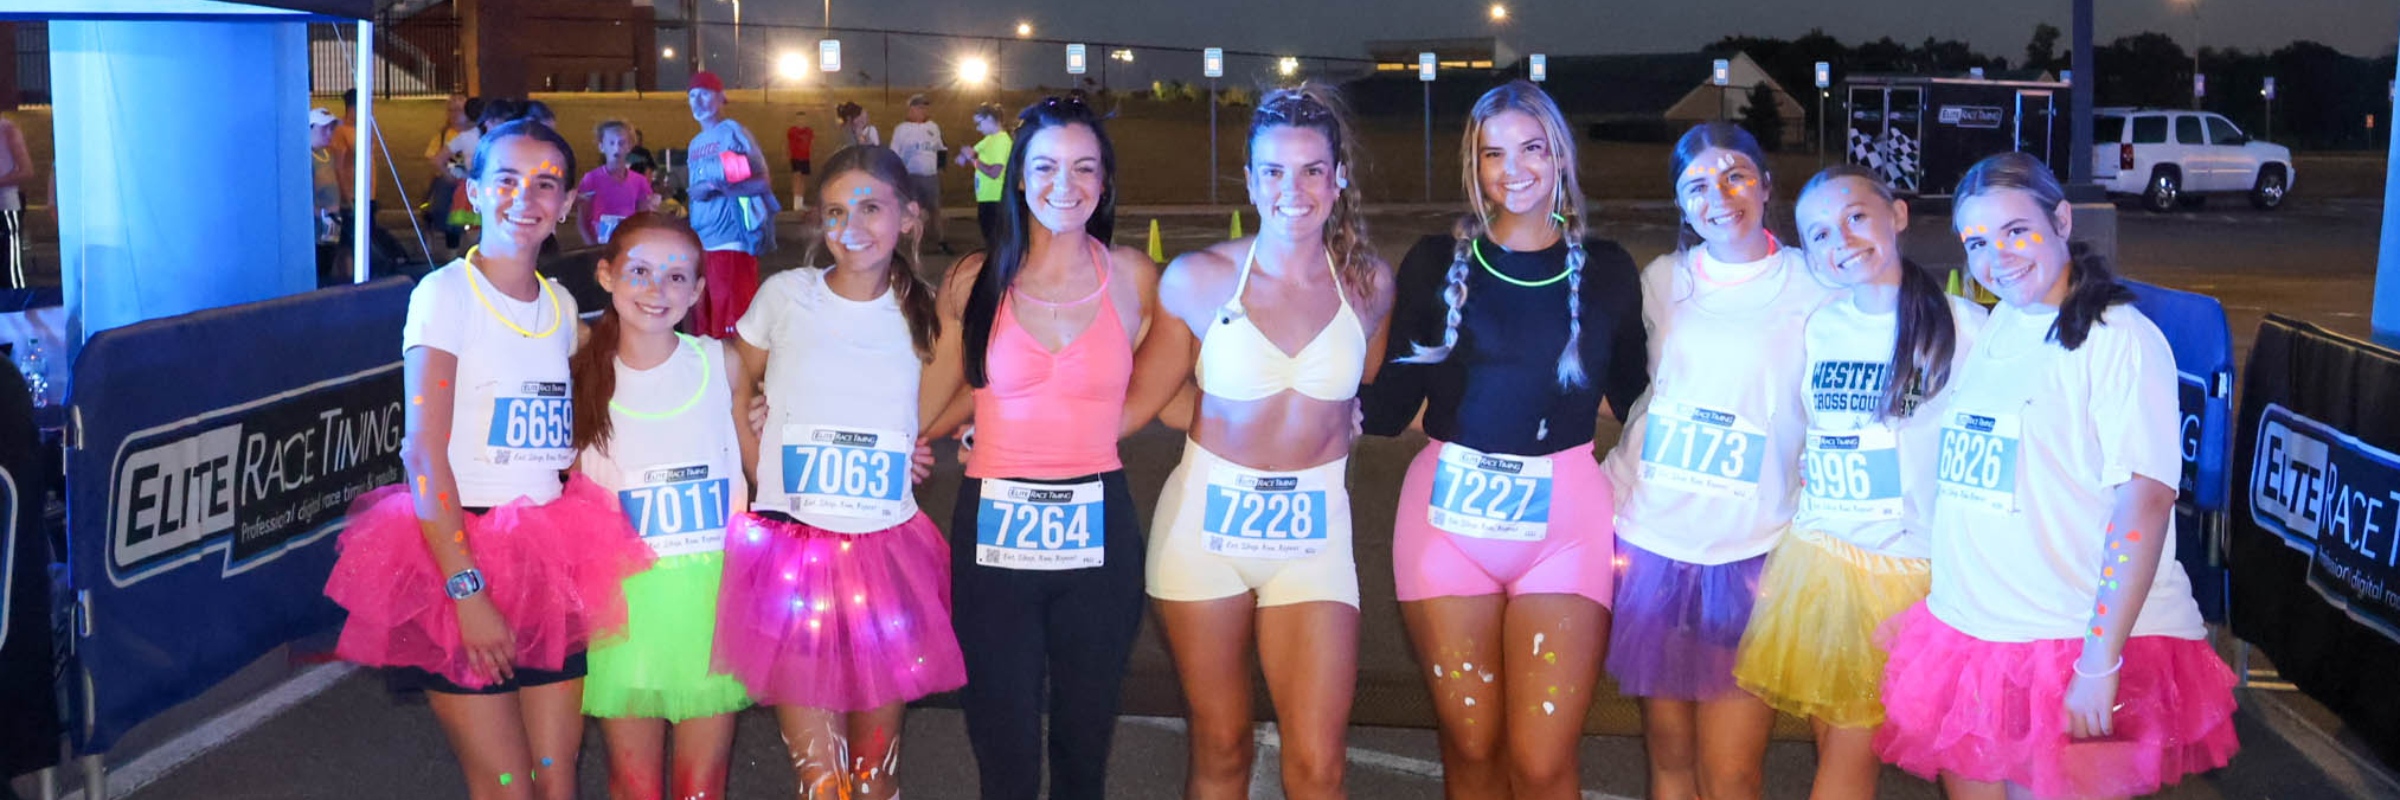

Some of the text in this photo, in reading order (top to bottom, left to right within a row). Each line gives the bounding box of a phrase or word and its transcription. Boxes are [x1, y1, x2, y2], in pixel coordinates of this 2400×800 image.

[506, 399, 573, 448] 6659
[1814, 393, 1848, 410] ROSS
[126, 401, 401, 547] ELITE RACE TIMING
[796, 446, 891, 499] 7063
[1655, 417, 1748, 478] 7173
[1940, 429, 2004, 489] 6826
[631, 481, 724, 536] 7011
[1220, 488, 1312, 539] 7228
[1443, 463, 1538, 521] 7227
[993, 501, 1090, 549] 7264
